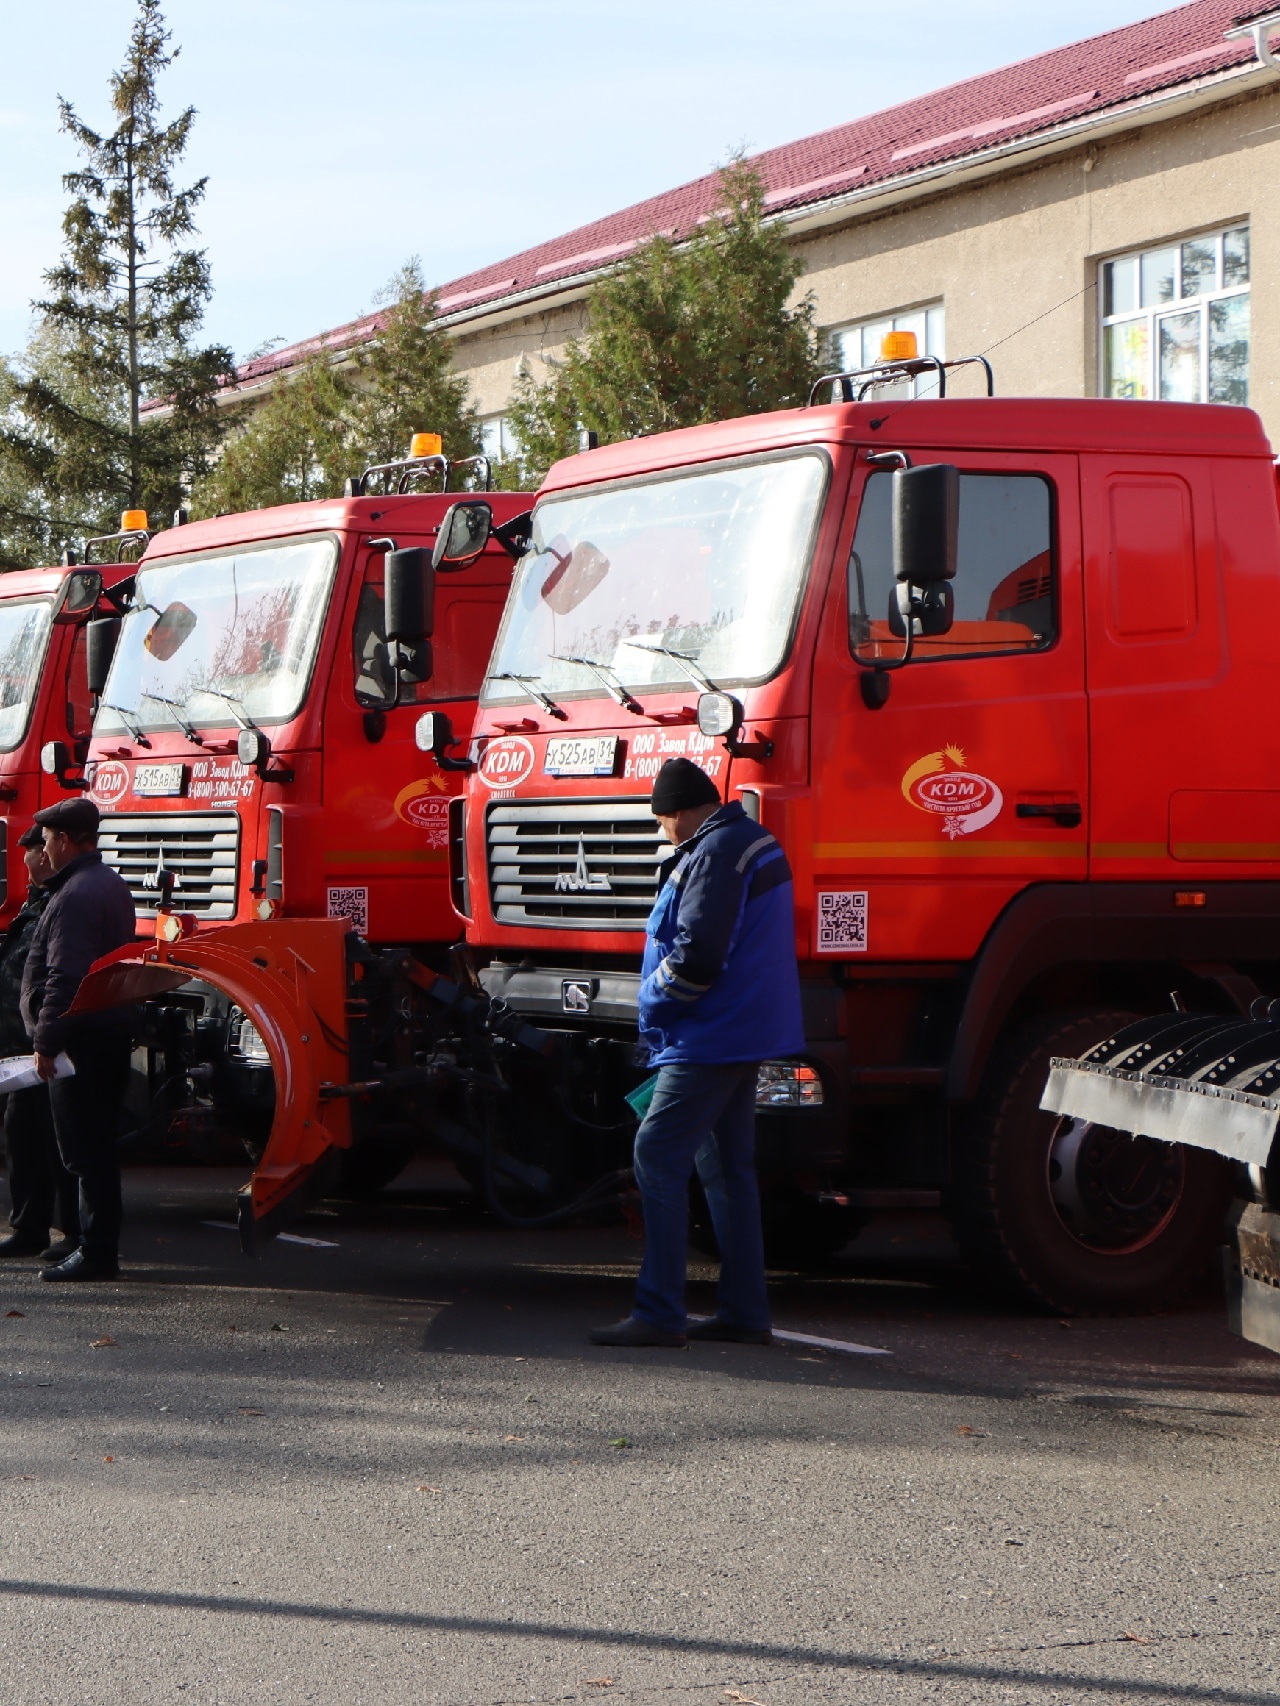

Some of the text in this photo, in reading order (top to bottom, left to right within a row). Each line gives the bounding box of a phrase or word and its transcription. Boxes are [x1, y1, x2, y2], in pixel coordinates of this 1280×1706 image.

[549, 740, 613, 766] Х525АВ 31
[633, 734, 655, 754] ООО
[486, 751, 525, 774] KDM
[95, 773, 122, 791] KDM
[930, 782, 975, 796] KDM
